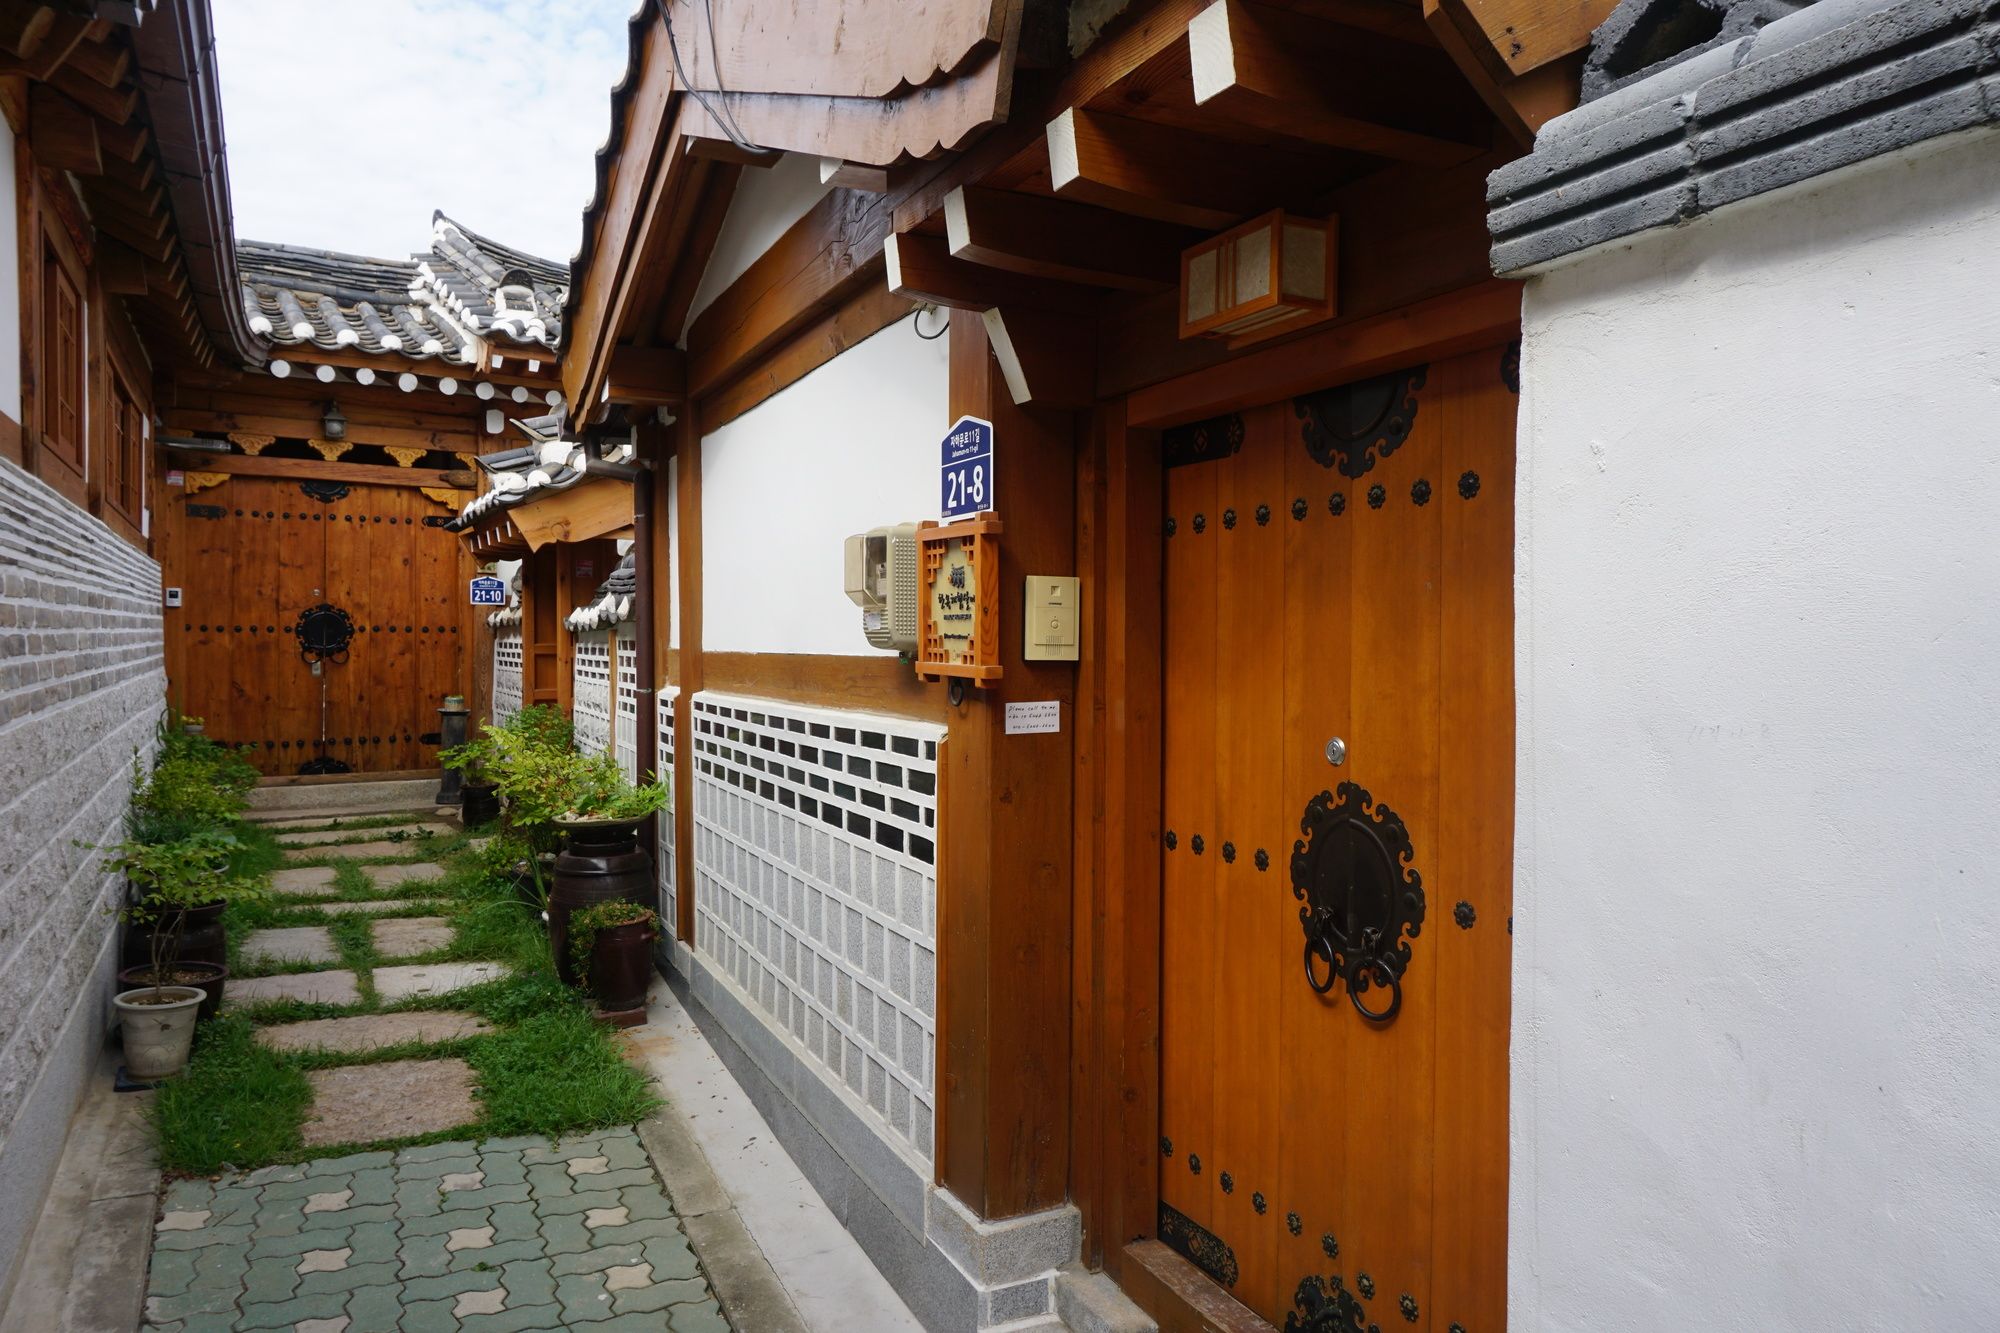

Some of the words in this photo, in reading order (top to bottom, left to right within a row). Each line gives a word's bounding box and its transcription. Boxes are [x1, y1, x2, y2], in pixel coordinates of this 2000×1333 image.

[950, 427, 980, 448] 자하문로11길
[947, 465, 984, 508] 21-8
[474, 590, 501, 601] 21-10
